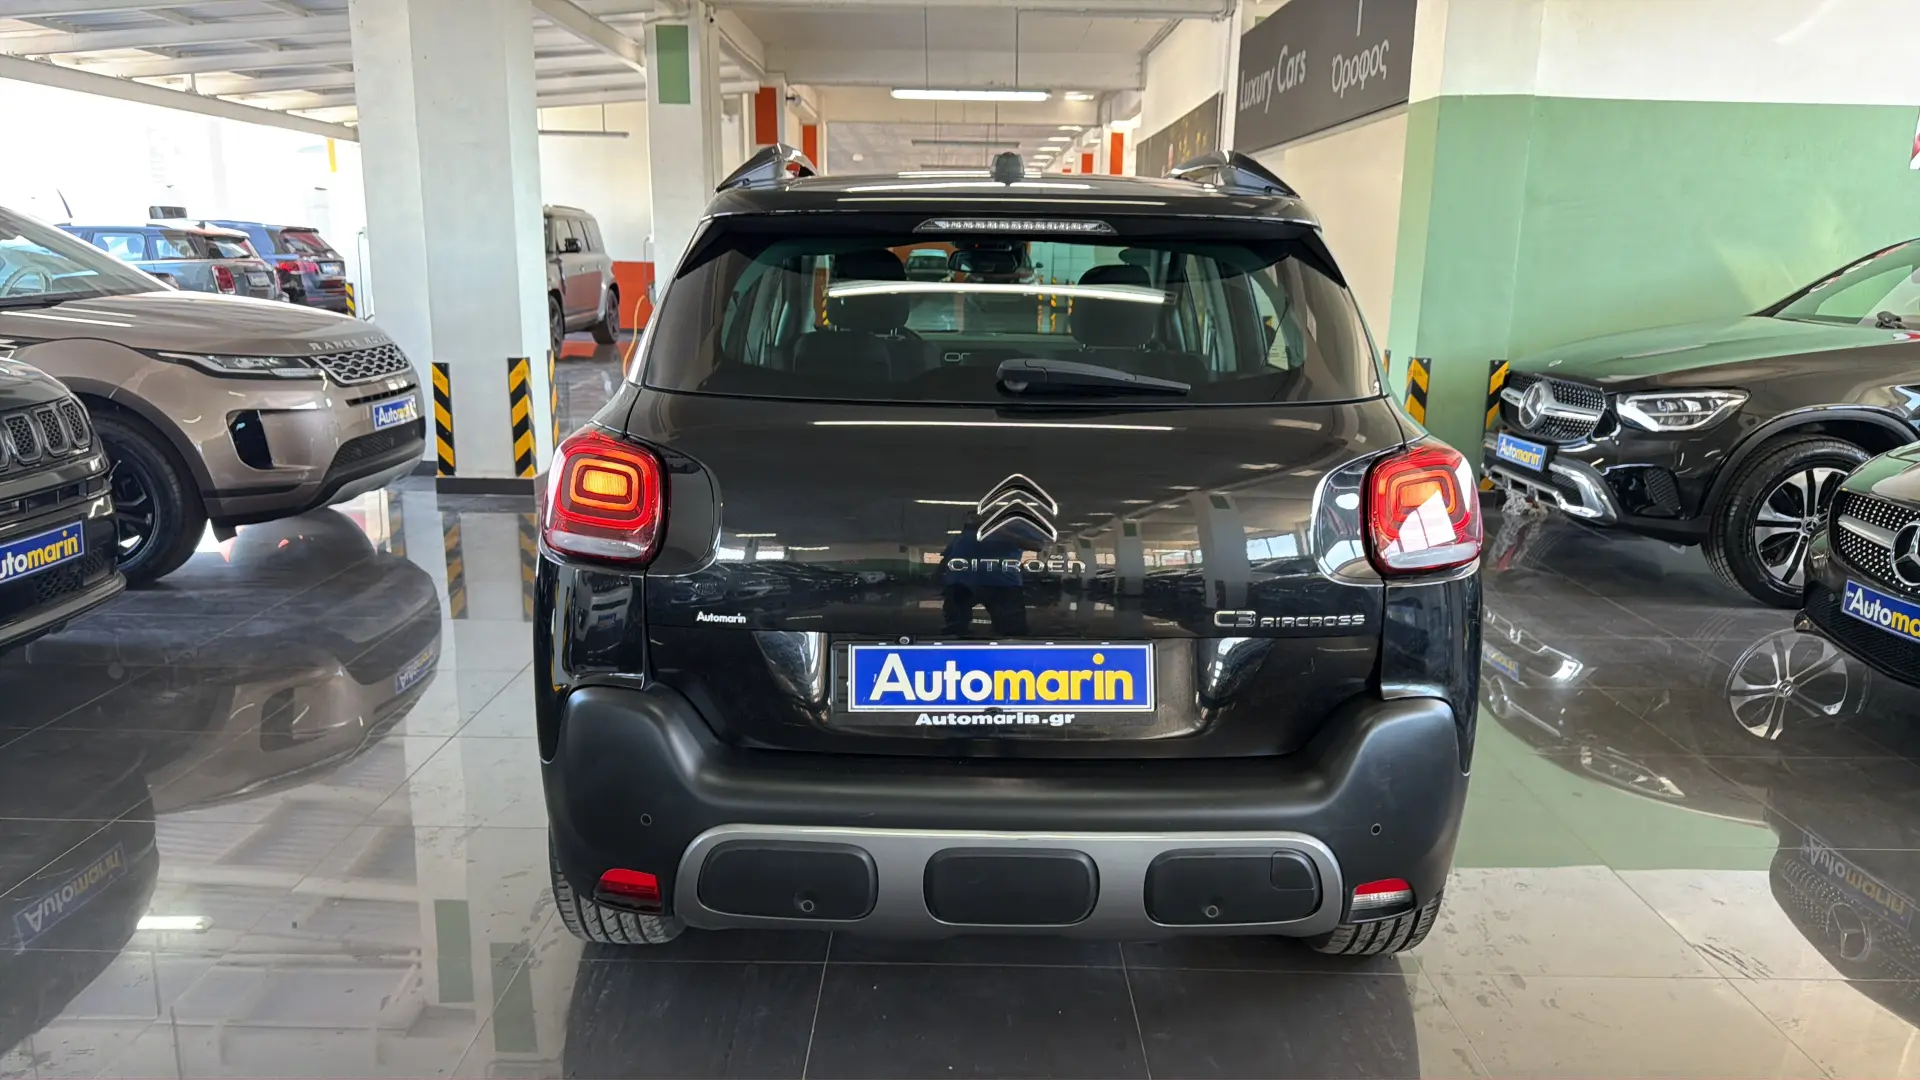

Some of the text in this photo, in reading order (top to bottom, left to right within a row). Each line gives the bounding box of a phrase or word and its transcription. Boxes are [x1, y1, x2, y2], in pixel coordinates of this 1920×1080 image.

[1238, 44, 1307, 114] Luxury Cars
[696, 610, 747, 624] Automarin
[1213, 610, 1366, 628] C3 AIRCROSS
[868, 652, 1135, 701] Automarin
[915, 711, 1076, 726] Automarin.gr
